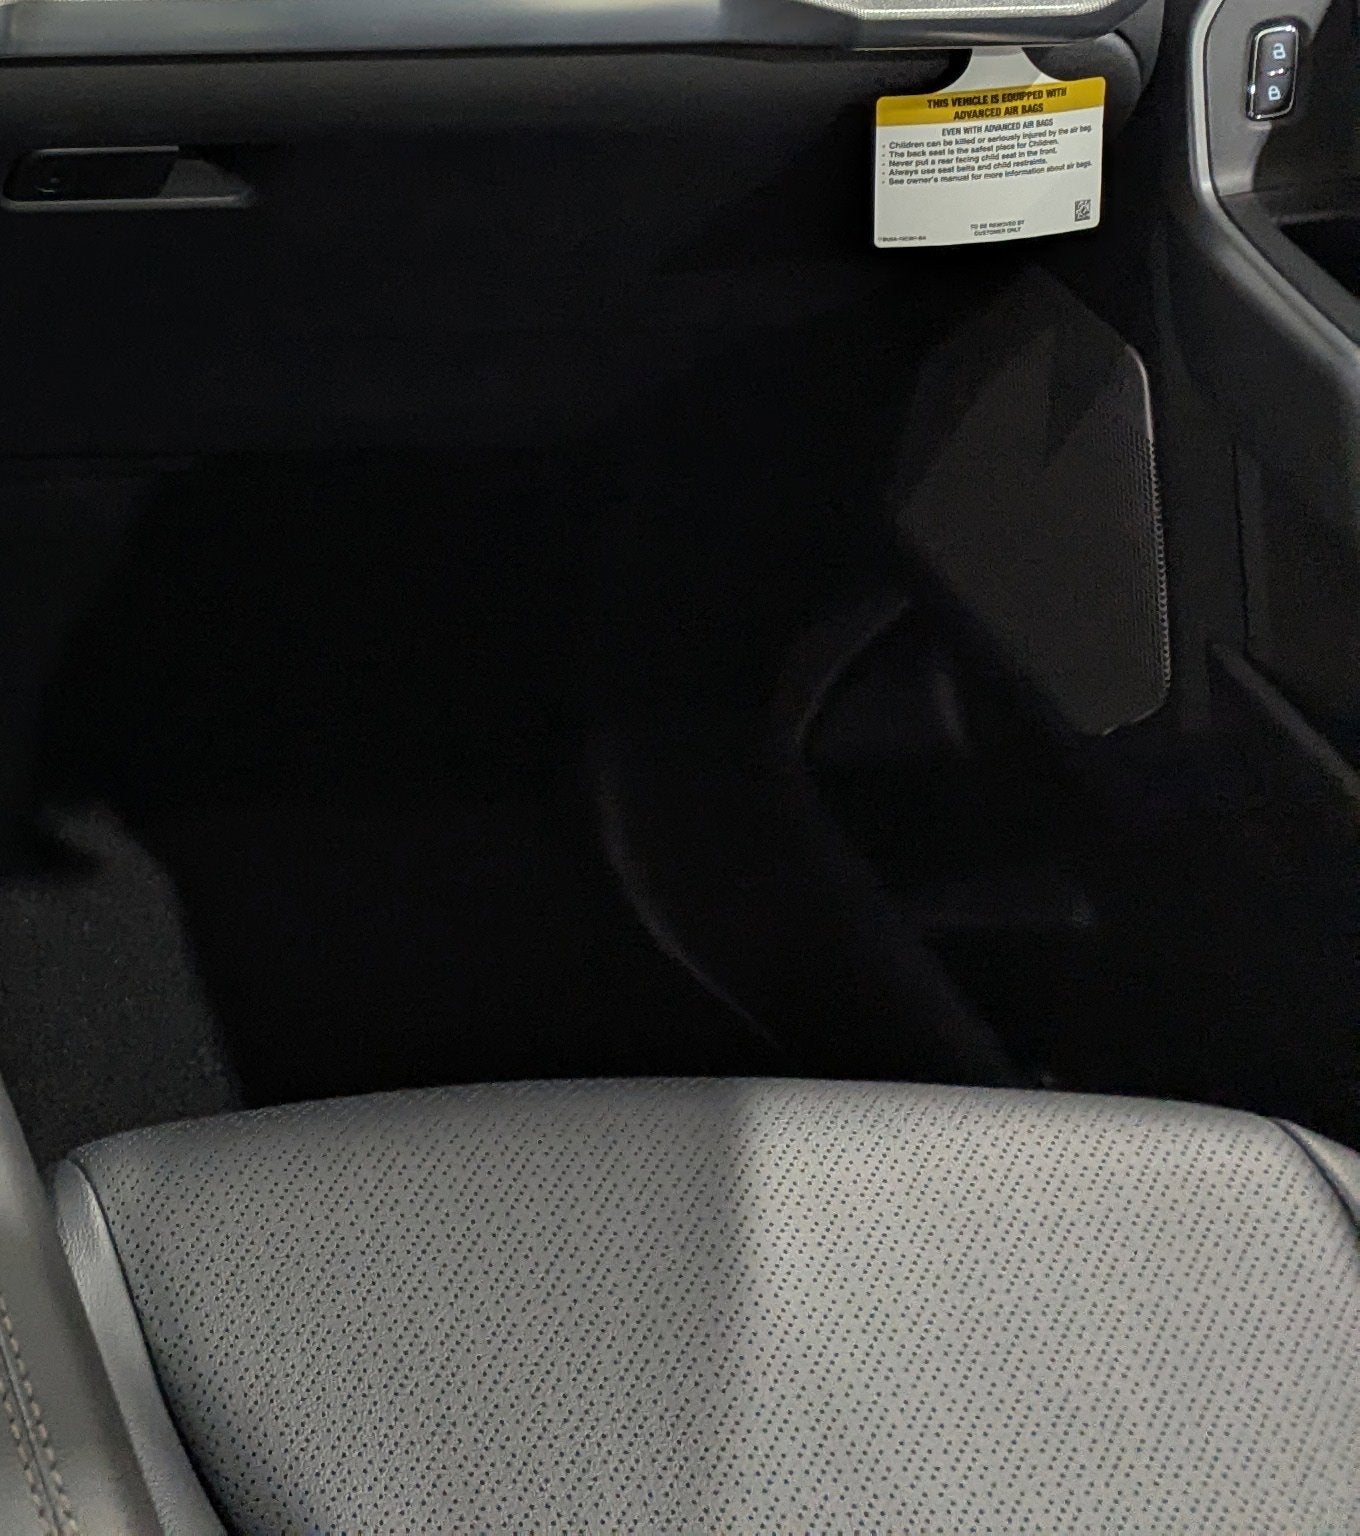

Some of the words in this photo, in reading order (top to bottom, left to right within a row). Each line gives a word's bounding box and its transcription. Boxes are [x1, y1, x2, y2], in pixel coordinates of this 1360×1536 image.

[926, 98, 949, 109] THIS
[952, 94, 988, 108] VEHICLE
[990, 93, 1000, 104] IS
[1002, 90, 1043, 103] EQUIPPED
[1046, 87, 1067, 98] WITH
[953, 107, 1001, 121] ADVANCED
[1004, 106, 1019, 116] AIR
[1021, 103, 1044, 115] BAGS
[941, 127, 961, 136] EVEN
[984, 122, 1020, 133] ADVANCED
[1036, 118, 1053, 128] BAGS
